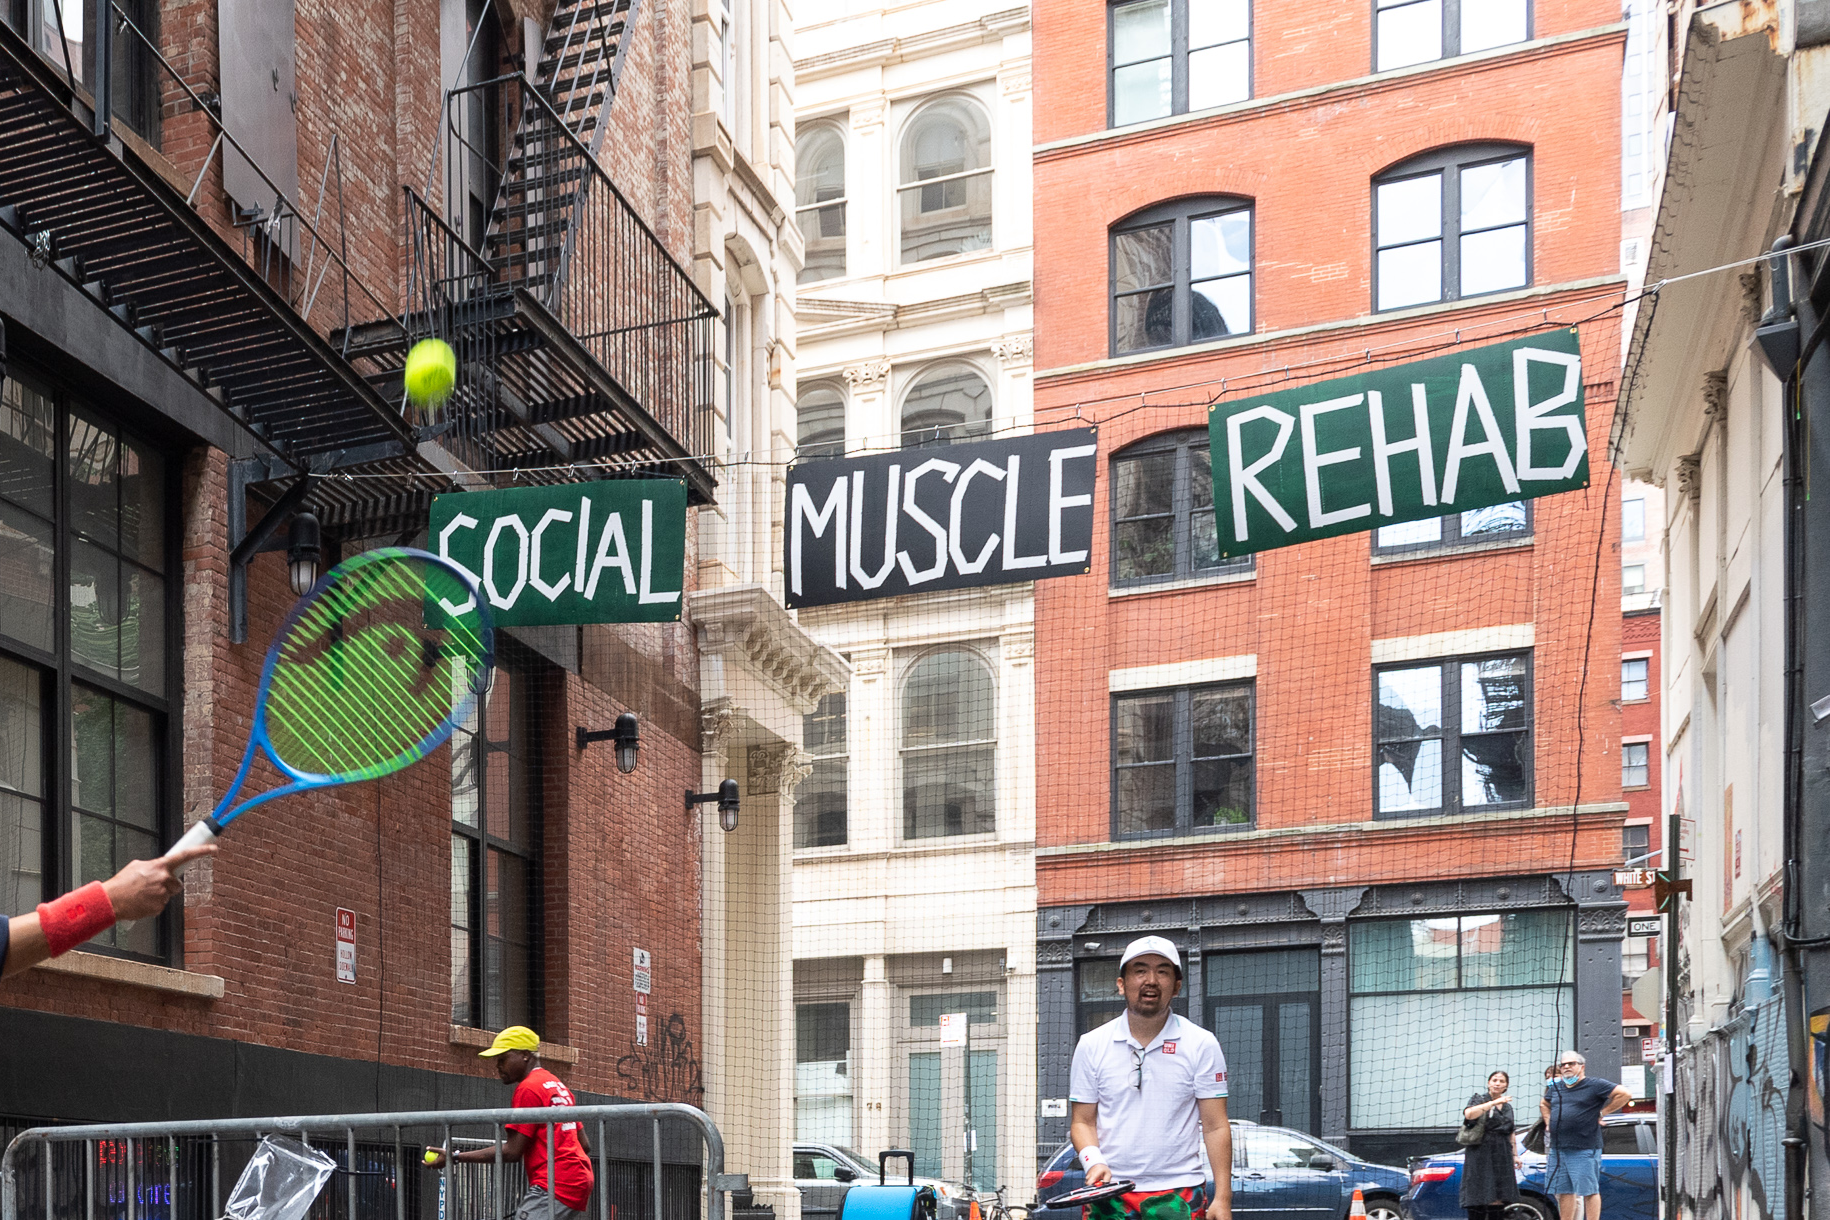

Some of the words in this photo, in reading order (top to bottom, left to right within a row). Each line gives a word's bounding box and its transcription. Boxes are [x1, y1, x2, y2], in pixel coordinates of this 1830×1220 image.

[1225, 346, 1586, 543] REHAB
[790, 443, 1097, 597] MUSCLE
[437, 496, 682, 618] SOCIAL
[1615, 870, 1643, 885] WHITE
[341, 913, 350, 927] NO
[1633, 921, 1656, 932] ONE
